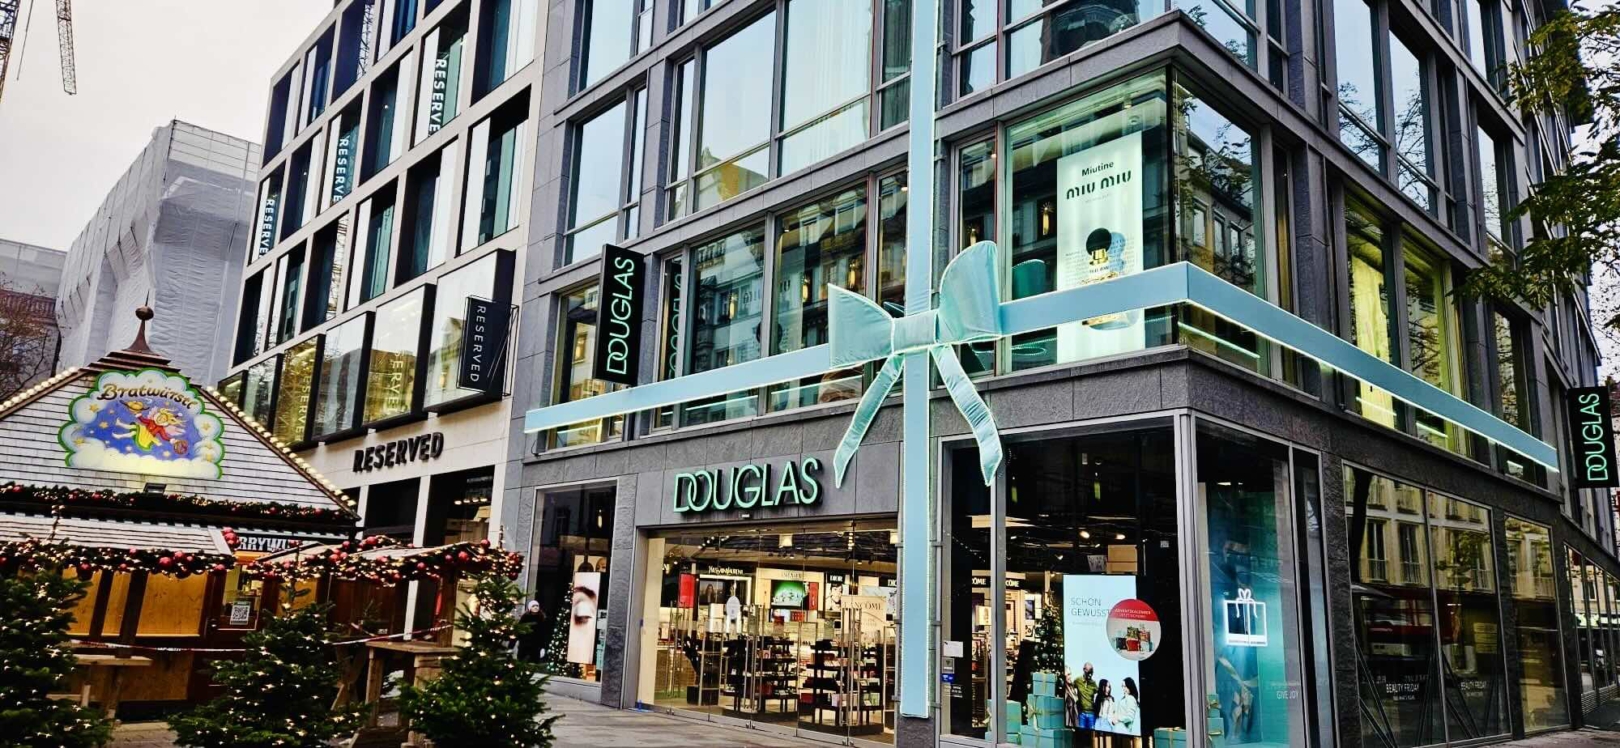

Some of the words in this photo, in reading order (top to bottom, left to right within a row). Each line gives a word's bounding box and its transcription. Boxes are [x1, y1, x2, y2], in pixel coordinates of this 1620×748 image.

[428, 58, 447, 136] RESERVE
[333, 138, 350, 202] RESERVE
[1082, 161, 1114, 176] Miutine
[259, 199, 276, 257] RESERVE
[470, 305, 487, 382] RESERVED
[606, 256, 635, 375] DOUGLAS
[352, 431, 444, 473] RESERVED
[1579, 393, 1608, 481] DOUGLAS
[673, 457, 823, 513] DOUGLAS
